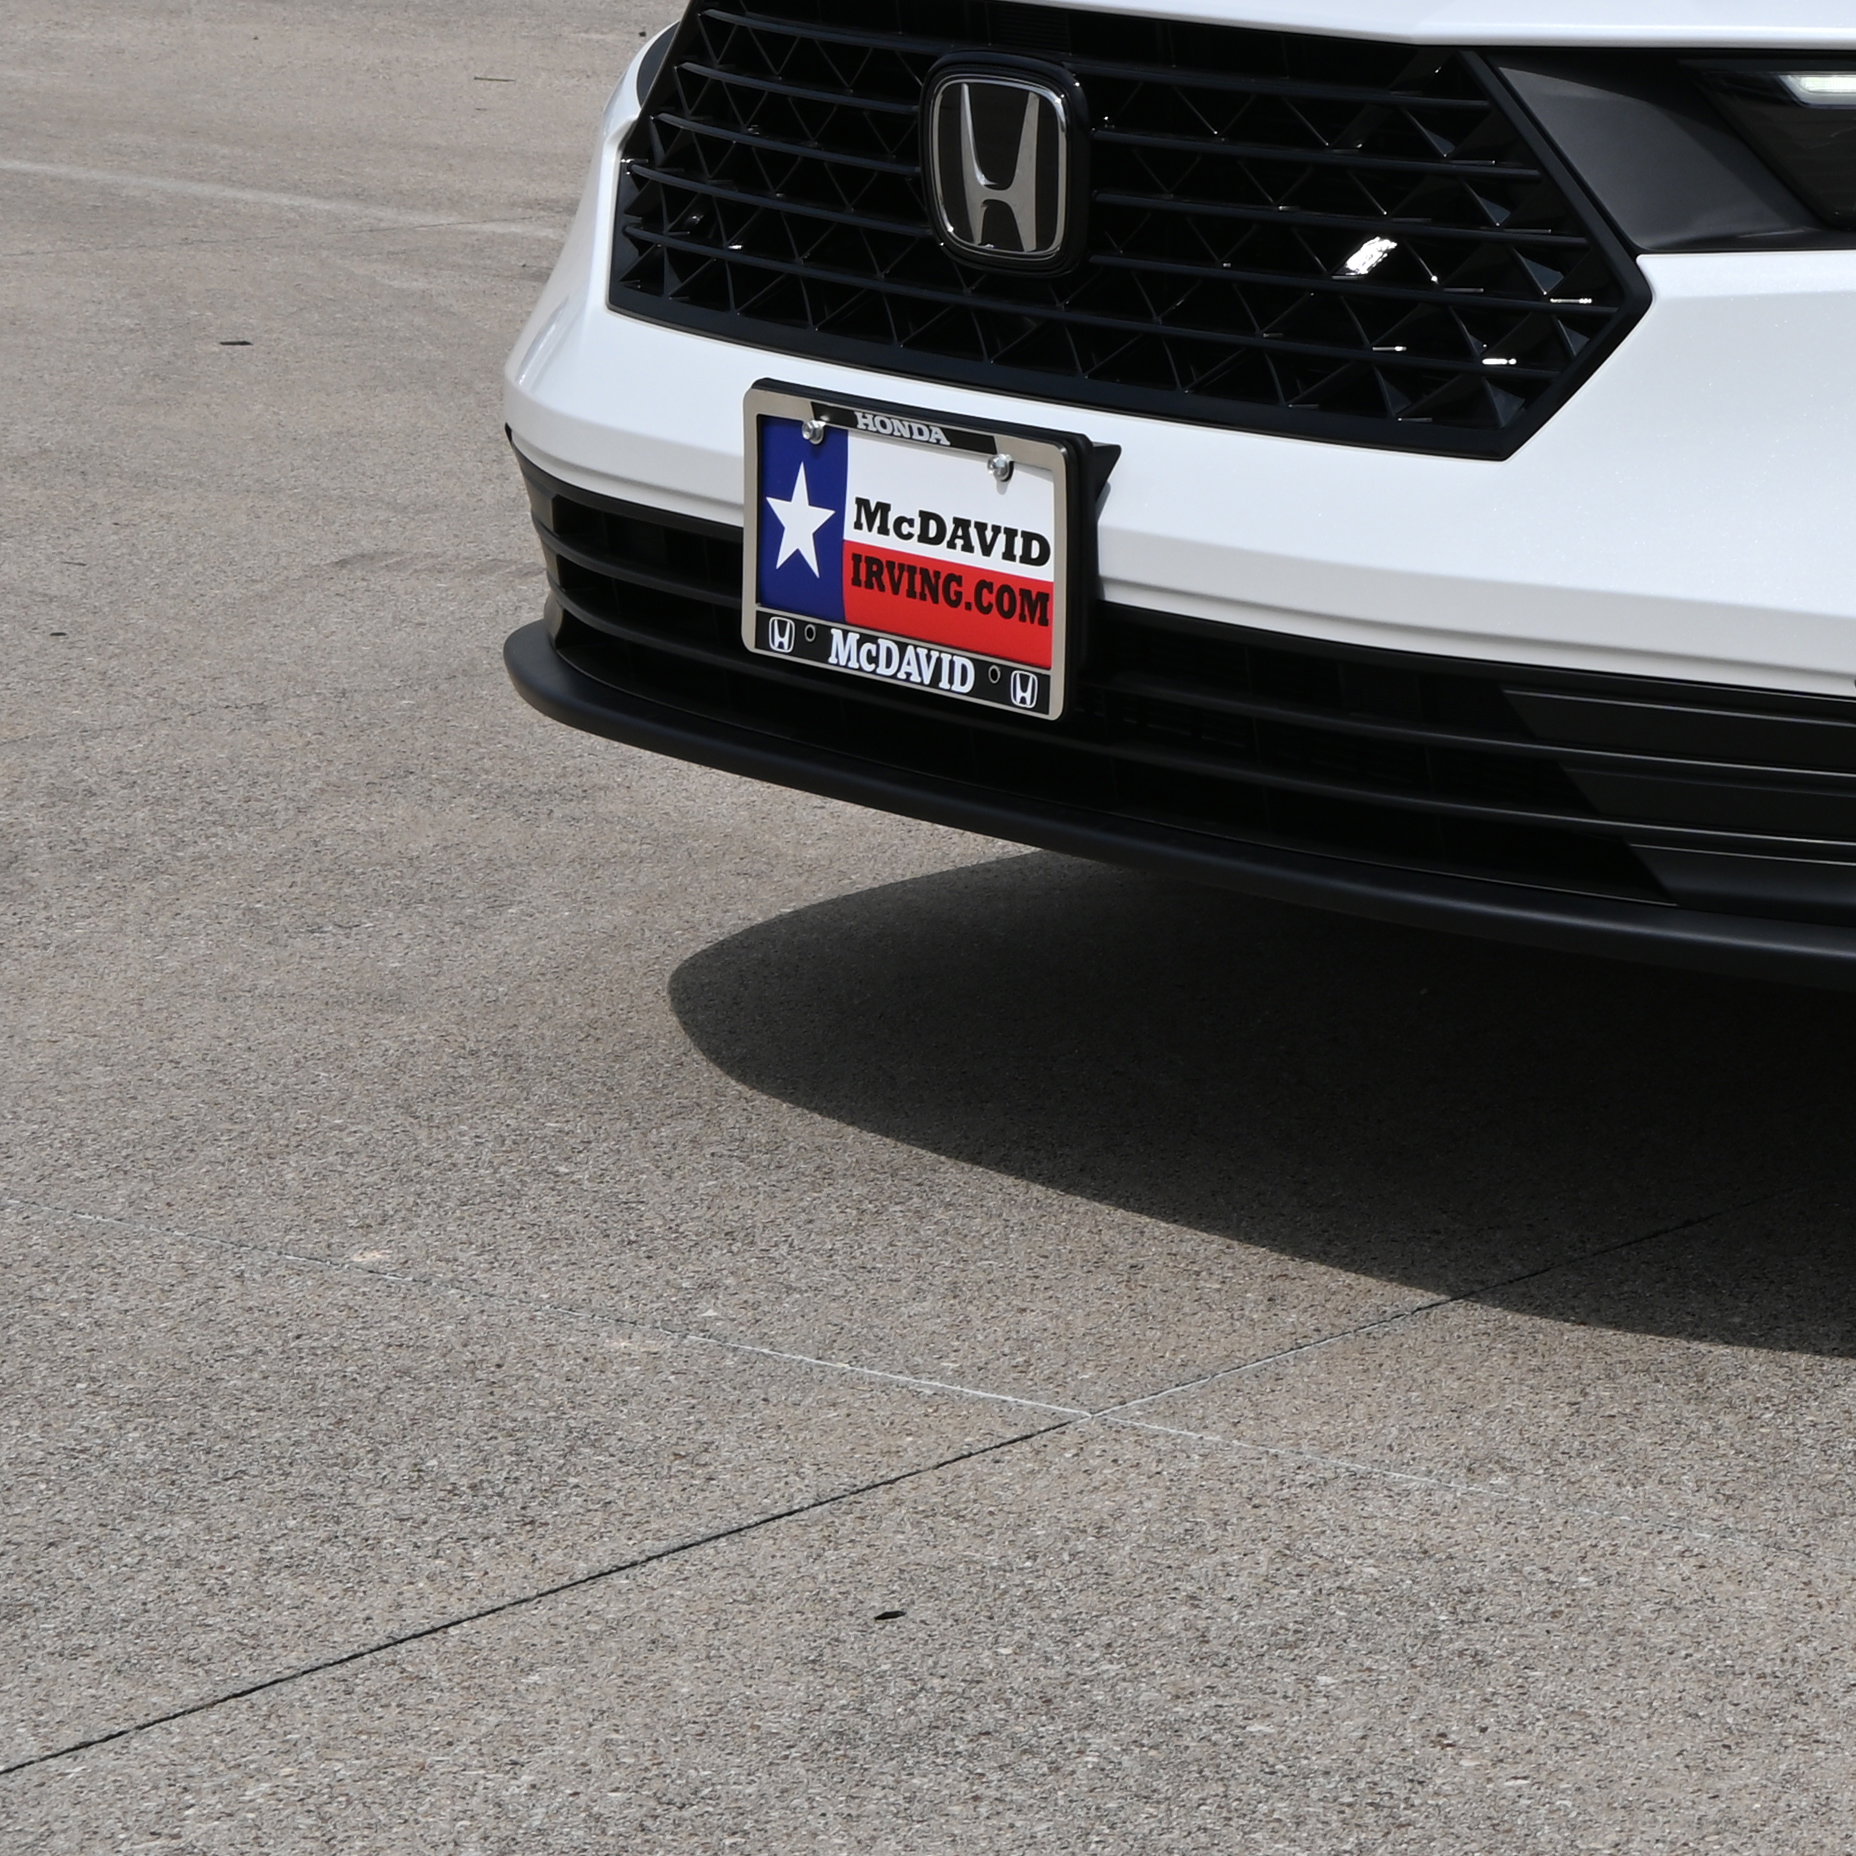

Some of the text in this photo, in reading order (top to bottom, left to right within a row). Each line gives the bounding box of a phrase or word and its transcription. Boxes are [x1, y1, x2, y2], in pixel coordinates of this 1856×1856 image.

[853, 411, 951, 446] HONDA
[853, 497, 1051, 567] McDAVID
[850, 553, 1050, 627] IRVING.COM
[828, 628, 975, 694] McDAVID
